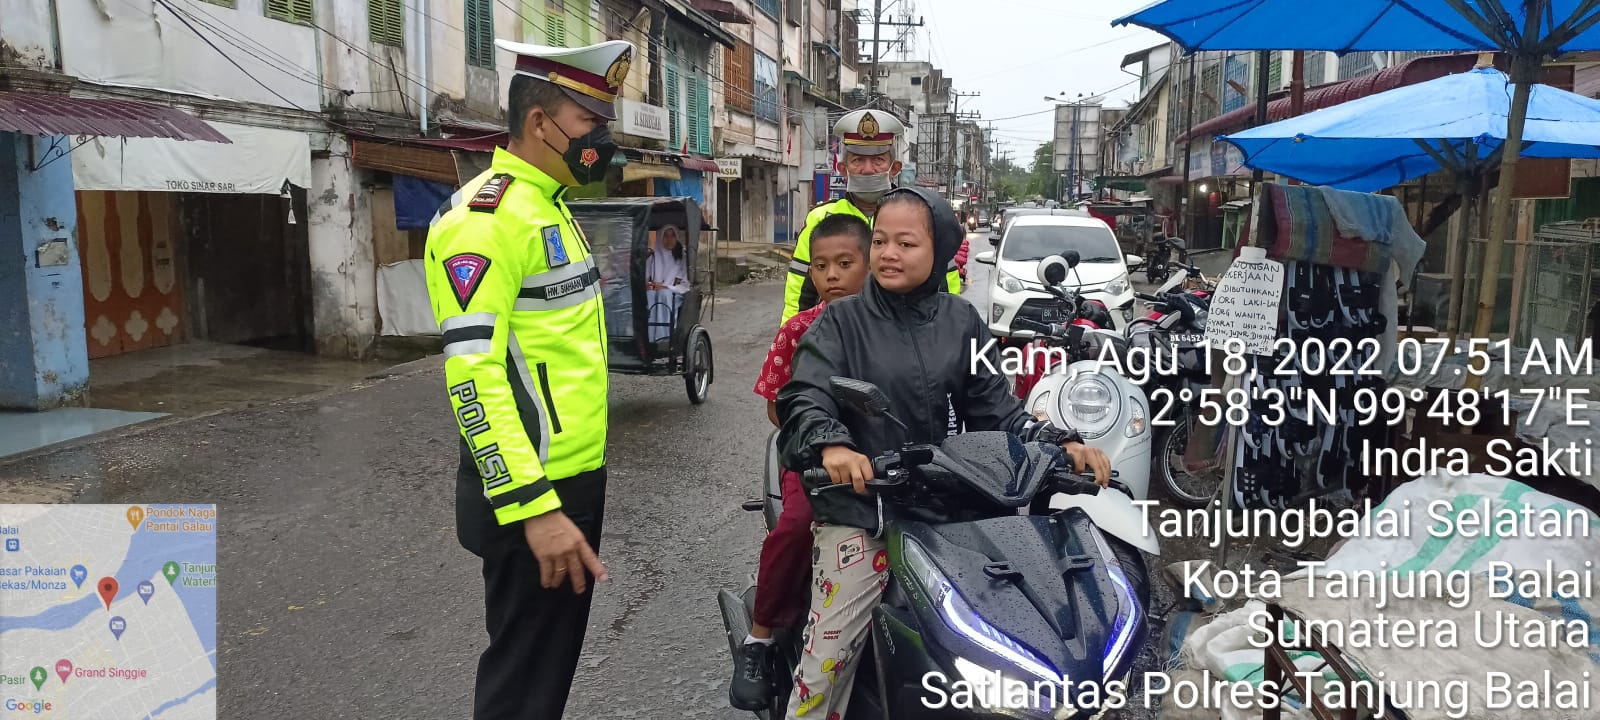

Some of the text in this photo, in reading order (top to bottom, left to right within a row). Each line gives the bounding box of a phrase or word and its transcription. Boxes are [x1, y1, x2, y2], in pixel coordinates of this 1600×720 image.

[165, 180, 236, 192] TOKO SINAR SARI
[1234, 311, 1266, 320] WANITA
[1181, 334, 1200, 342] 6452
[450, 379, 513, 490] POLISI
